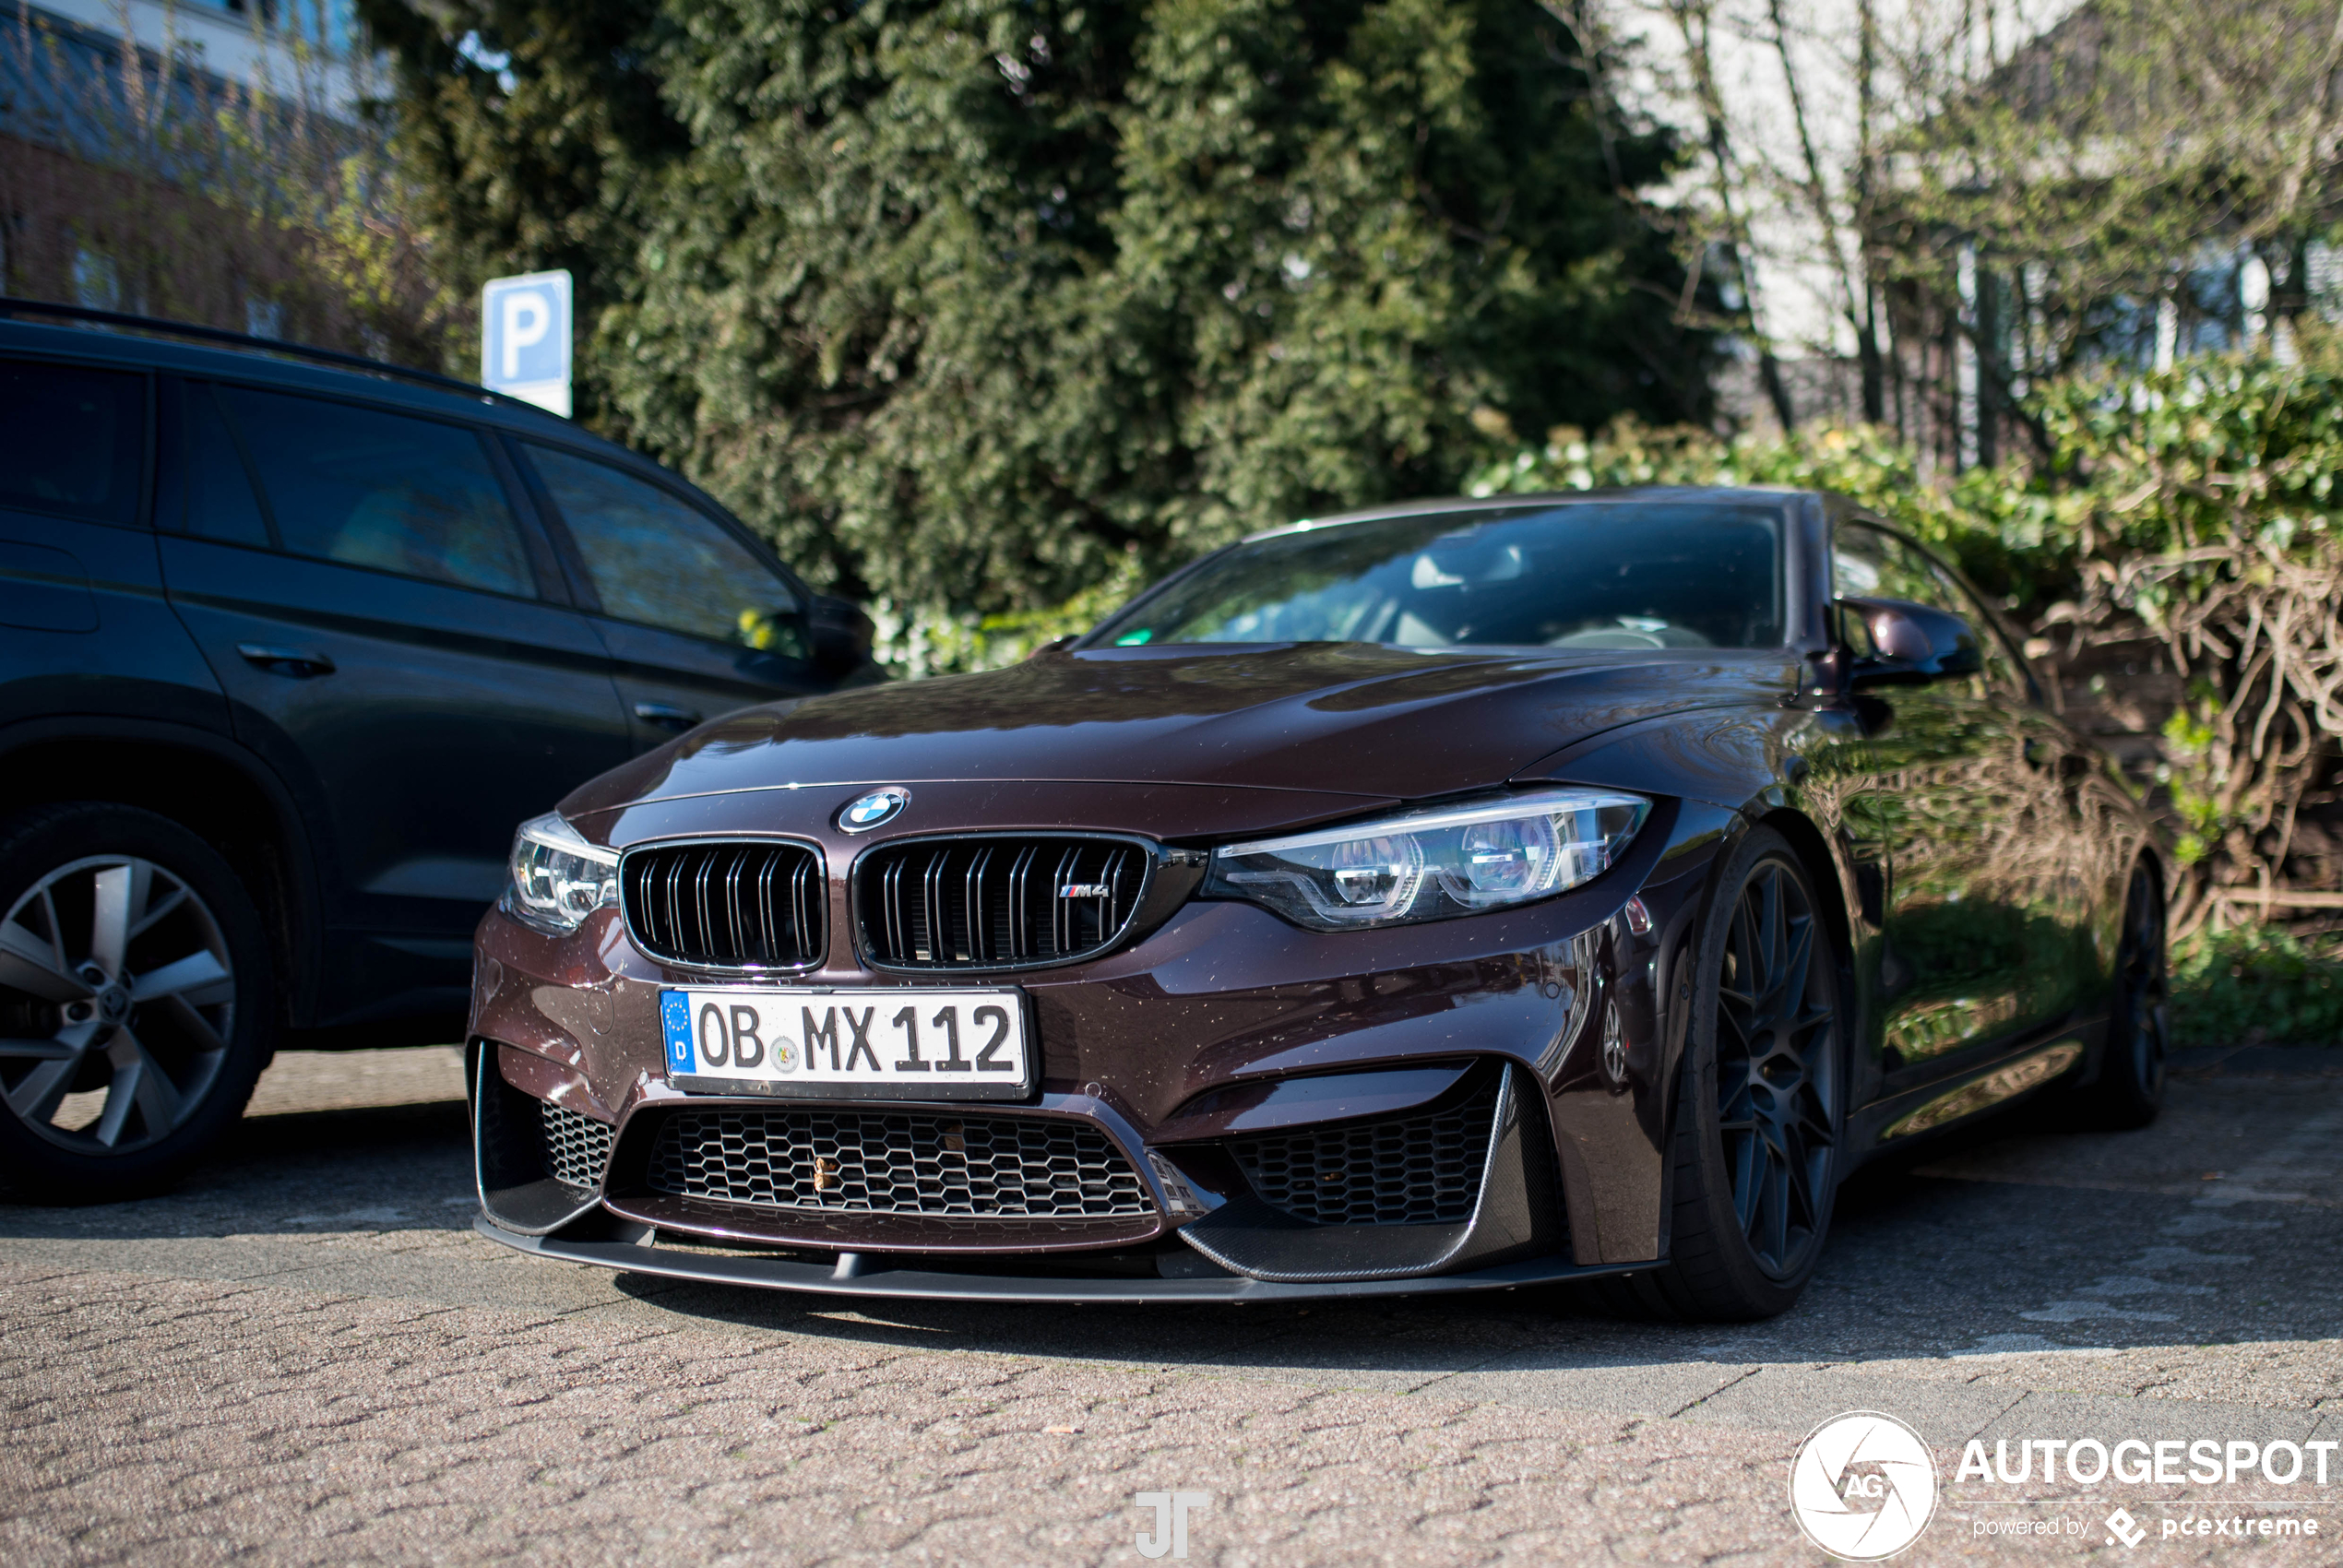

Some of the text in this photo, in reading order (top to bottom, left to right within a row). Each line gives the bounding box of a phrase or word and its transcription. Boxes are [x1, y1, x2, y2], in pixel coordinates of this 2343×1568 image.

[503, 291, 552, 379] P
[1073, 885, 1110, 897] M4
[675, 1043, 687, 1061] D
[698, 1002, 766, 1068] OB
